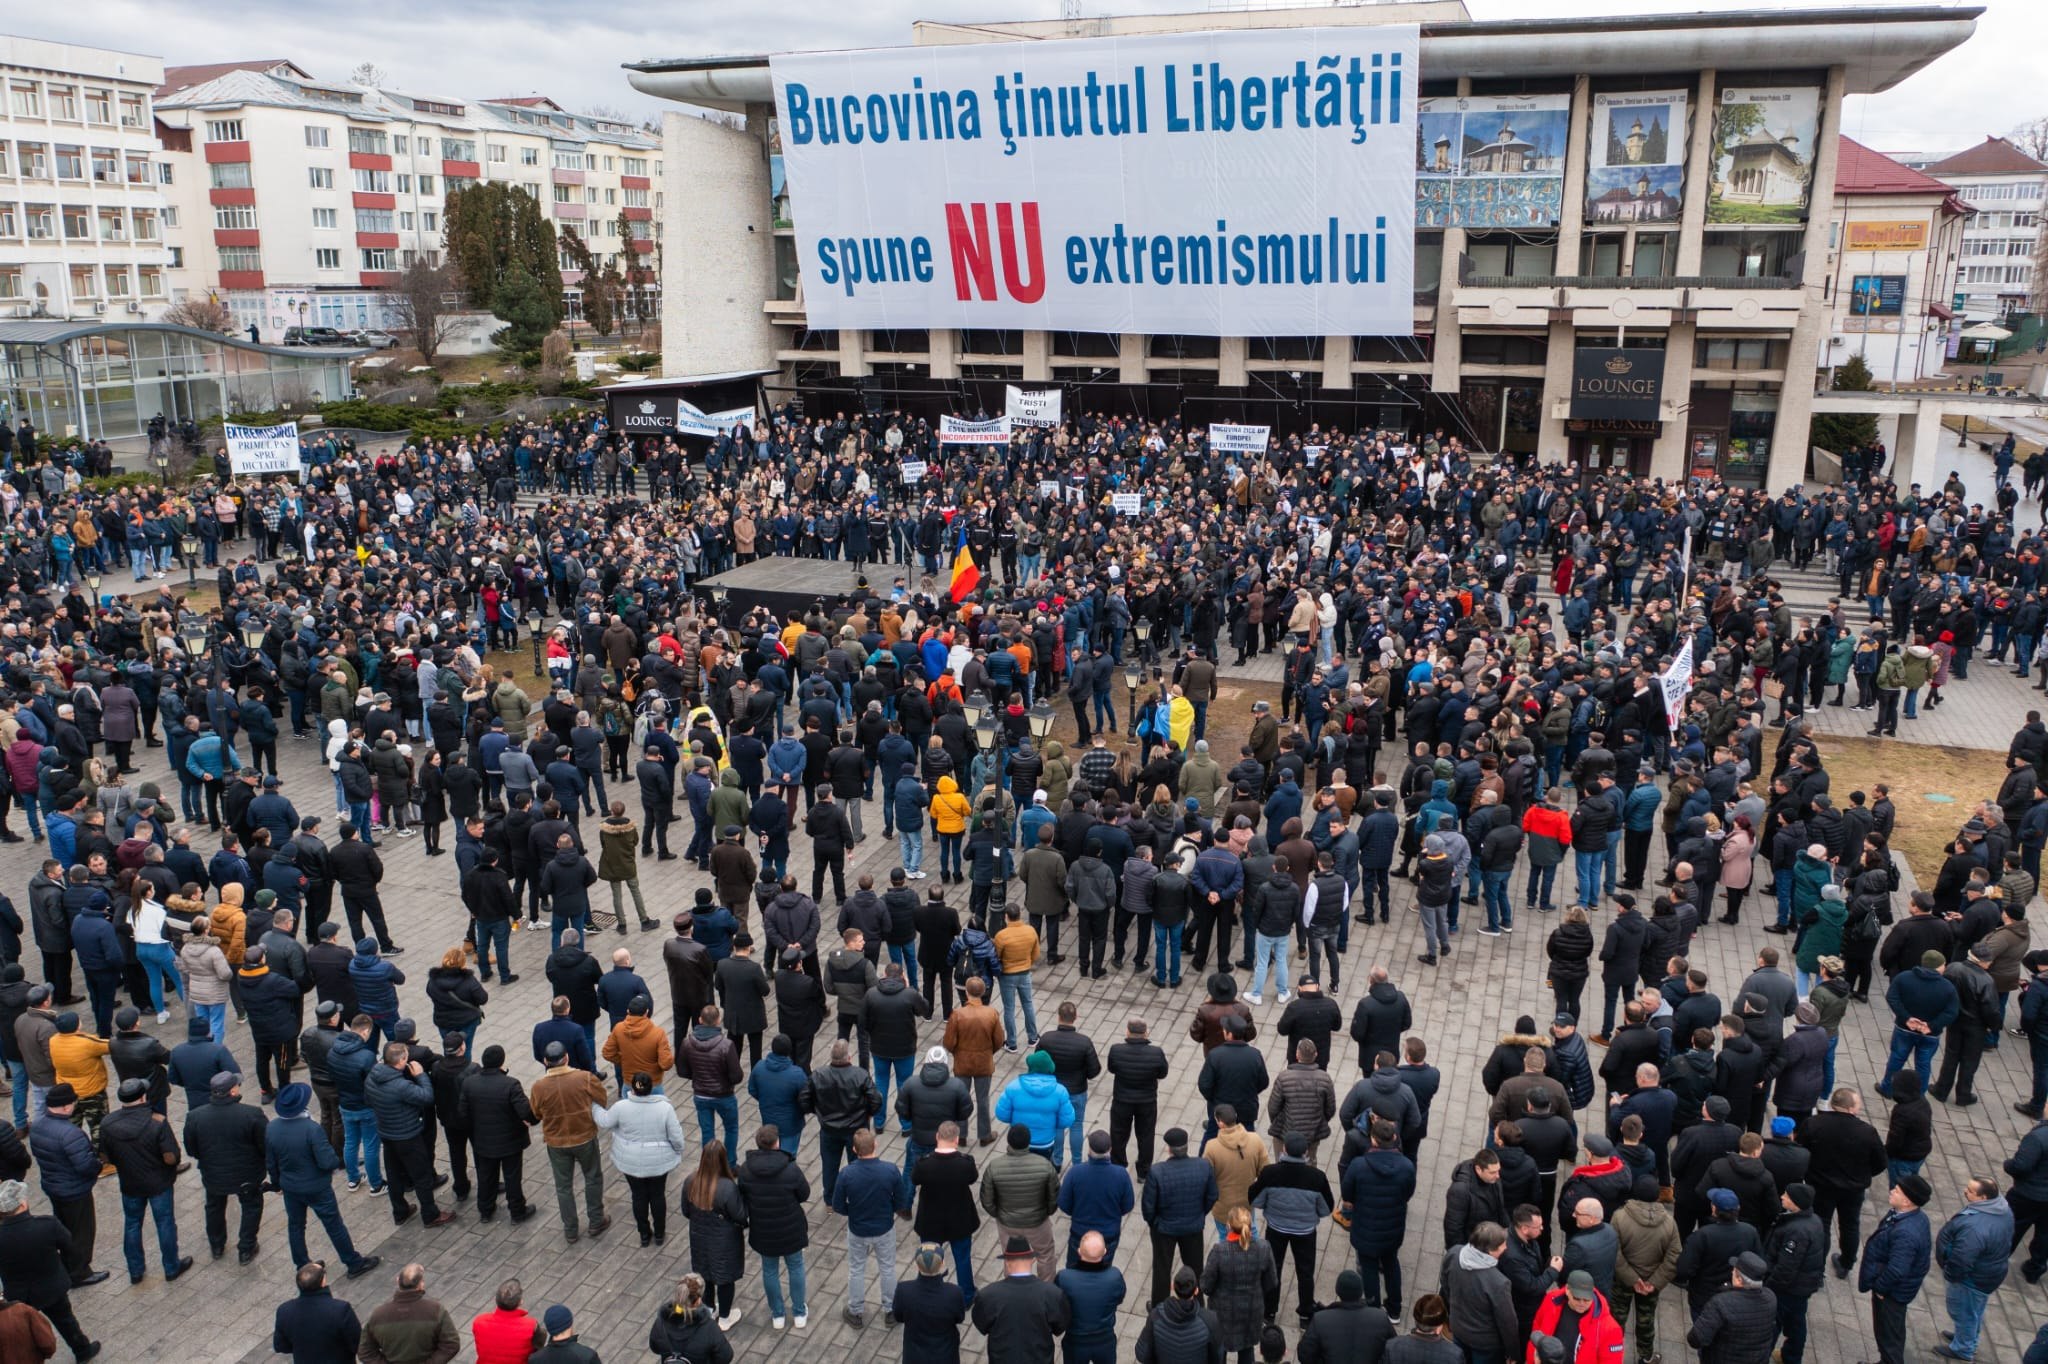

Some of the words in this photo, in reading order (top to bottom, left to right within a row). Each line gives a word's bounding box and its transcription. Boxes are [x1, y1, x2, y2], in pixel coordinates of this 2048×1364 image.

[785, 76, 982, 145] Bucovina
[1850, 224, 1924, 242] Monitorul
[817, 235, 934, 297] spune
[944, 201, 1046, 304] NU
[1065, 216, 1386, 286] extremismului
[1578, 378, 1655, 394] LOUNGE
[1025, 409, 1038, 417] CU
[226, 425, 297, 440] EXTREMISMUL
[273, 440, 291, 449] PAS
[254, 450, 276, 459] SPRE
